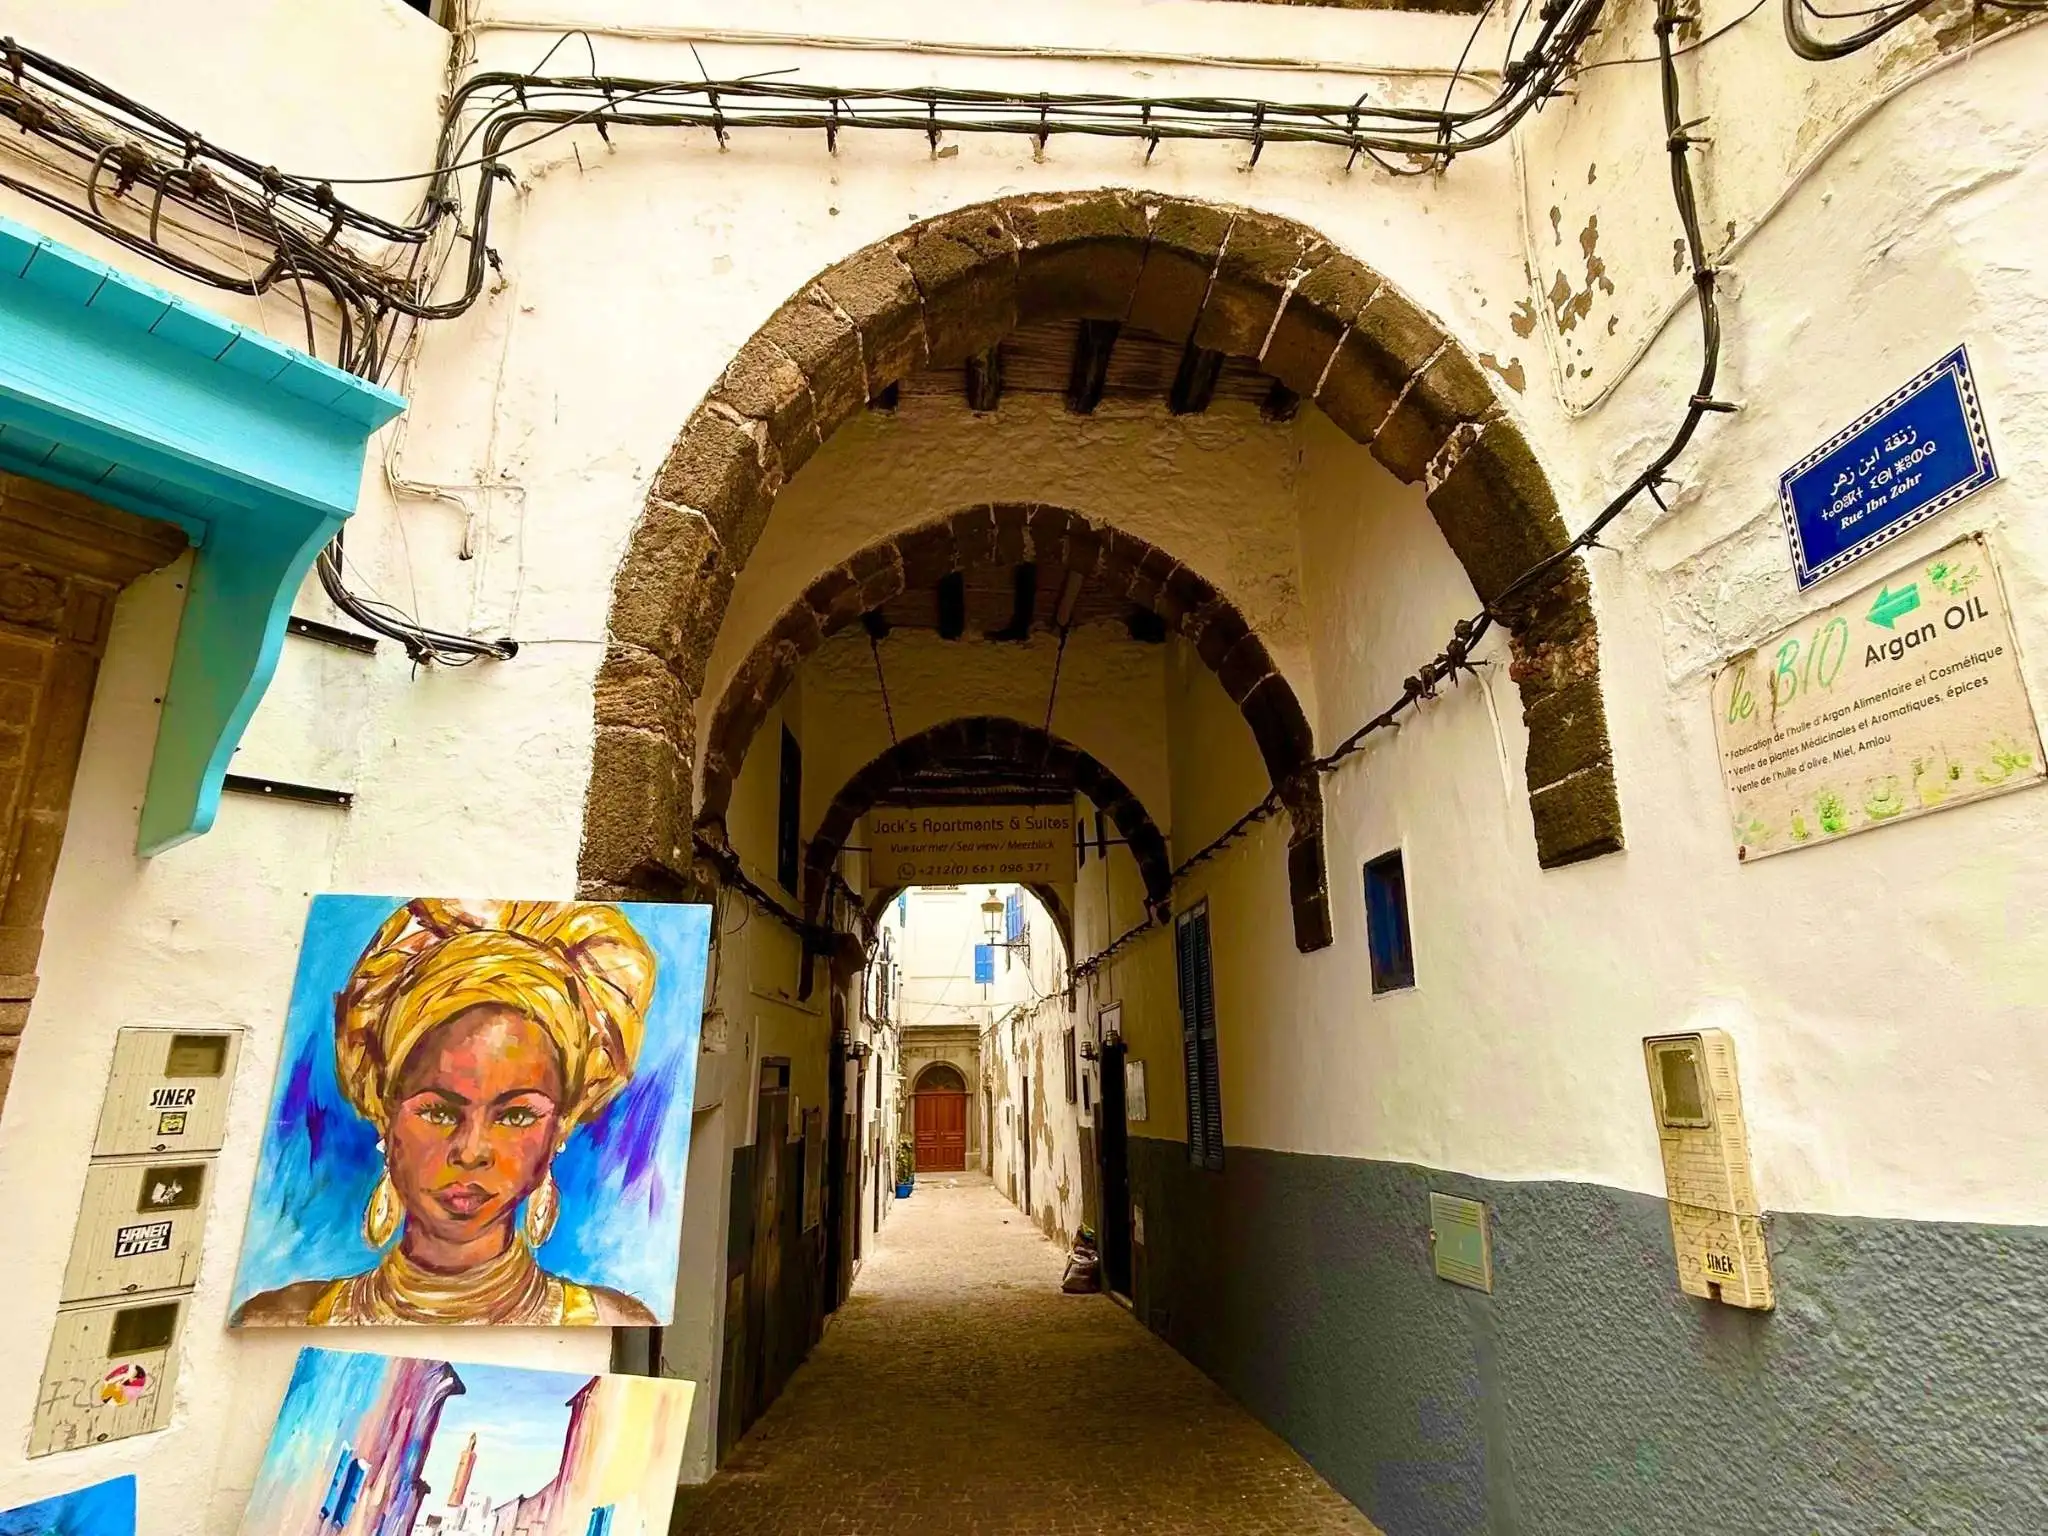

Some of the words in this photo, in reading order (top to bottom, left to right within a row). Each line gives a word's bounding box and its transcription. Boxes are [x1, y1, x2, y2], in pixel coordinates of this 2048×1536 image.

[1884, 425, 1917, 452] زنقة
[1830, 466, 1855, 496] زهر
[1859, 446, 1880, 476] ابن
[1841, 509, 1864, 529] Rue
[1865, 495, 1888, 514] Ibn
[1890, 473, 1922, 499] Zohr
[1864, 621, 1936, 668] Argan
[1944, 596, 1988, 631] OIL
[1728, 666, 1755, 725] le
[1774, 616, 1848, 707] BIO
[1773, 731, 1785, 743] de
[1786, 721, 1812, 737] l'huile
[1813, 706, 1851, 726] d'Argan
[1853, 682, 1912, 711] Alimentaire
[1915, 674, 1927, 687] et
[1929, 646, 2003, 681] Cosmétique
[1733, 763, 1756, 777] Vente
[1757, 757, 1768, 768] de
[1770, 744, 1800, 763] plantes
[1801, 724, 1857, 751] Médicinales
[1858, 719, 1869, 731] et
[1946, 676, 1989, 698] épices
[1736, 780, 1760, 793] Vente
[1760, 775, 1772, 786] de
[1772, 767, 1797, 782] l'huile
[1859, 734, 1892, 752] Amlou
[874, 818, 917, 834] Jack's
[922, 817, 1004, 836] Apartments
[1009, 815, 1020, 831] &
[1025, 815, 1069, 831] Suites
[972, 864, 995, 874] 661
[1026, 862, 1050, 873] 371
[150, 1088, 196, 1107] SINER
